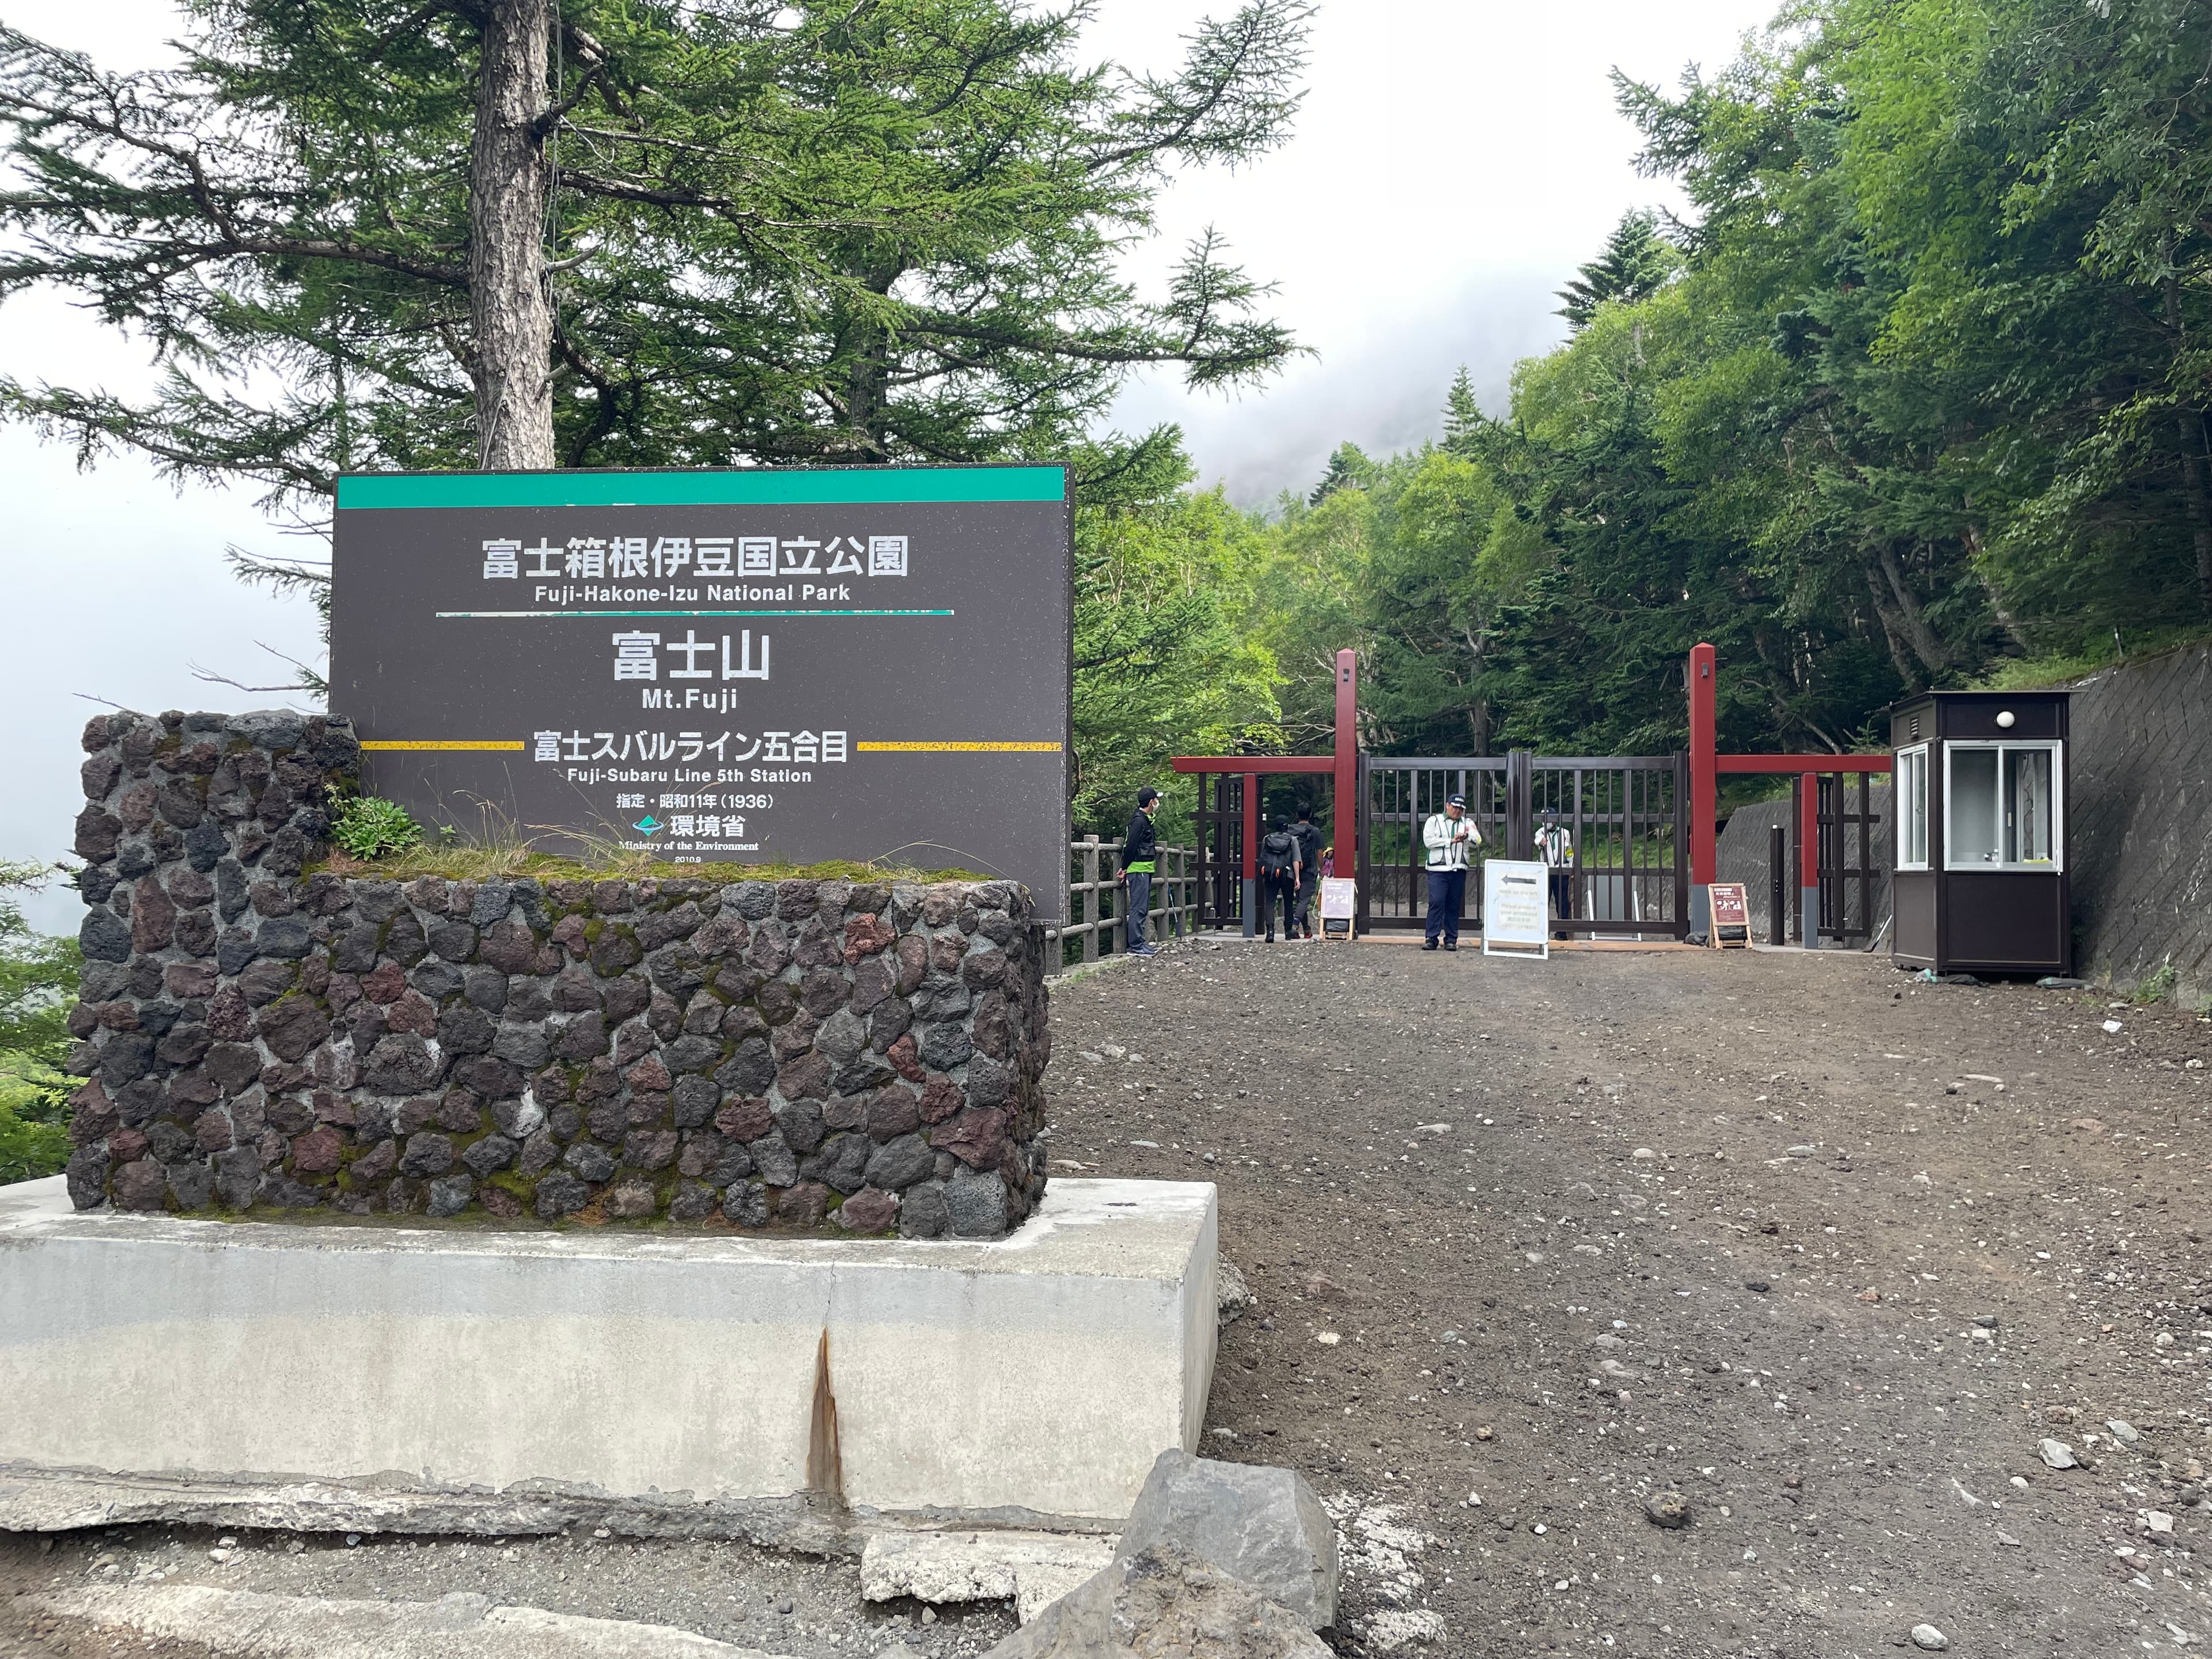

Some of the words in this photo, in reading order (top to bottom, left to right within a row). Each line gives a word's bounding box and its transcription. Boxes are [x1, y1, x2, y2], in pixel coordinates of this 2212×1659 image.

[482, 535, 908, 579] 富士箱根伊豆国立公園
[535, 584, 698, 606] Fuji-Hakone-Izu
[707, 584, 793, 601] National
[802, 583, 850, 601] Park
[612, 629, 770, 681] 富士山
[642, 688, 737, 714] Mt.Fuji
[533, 730, 847, 763] 富士スバルライン五合目
[567, 767, 668, 785] Fuji-Subaru
[675, 768, 711, 782] Line
[717, 768, 744, 783] 5th
[750, 768, 812, 782] Station
[669, 814, 747, 838] 環境省
[618, 840, 662, 852] Ministry
[664, 840, 675, 850] of
[676, 840, 693, 851] the
[695, 841, 759, 851] Environment
